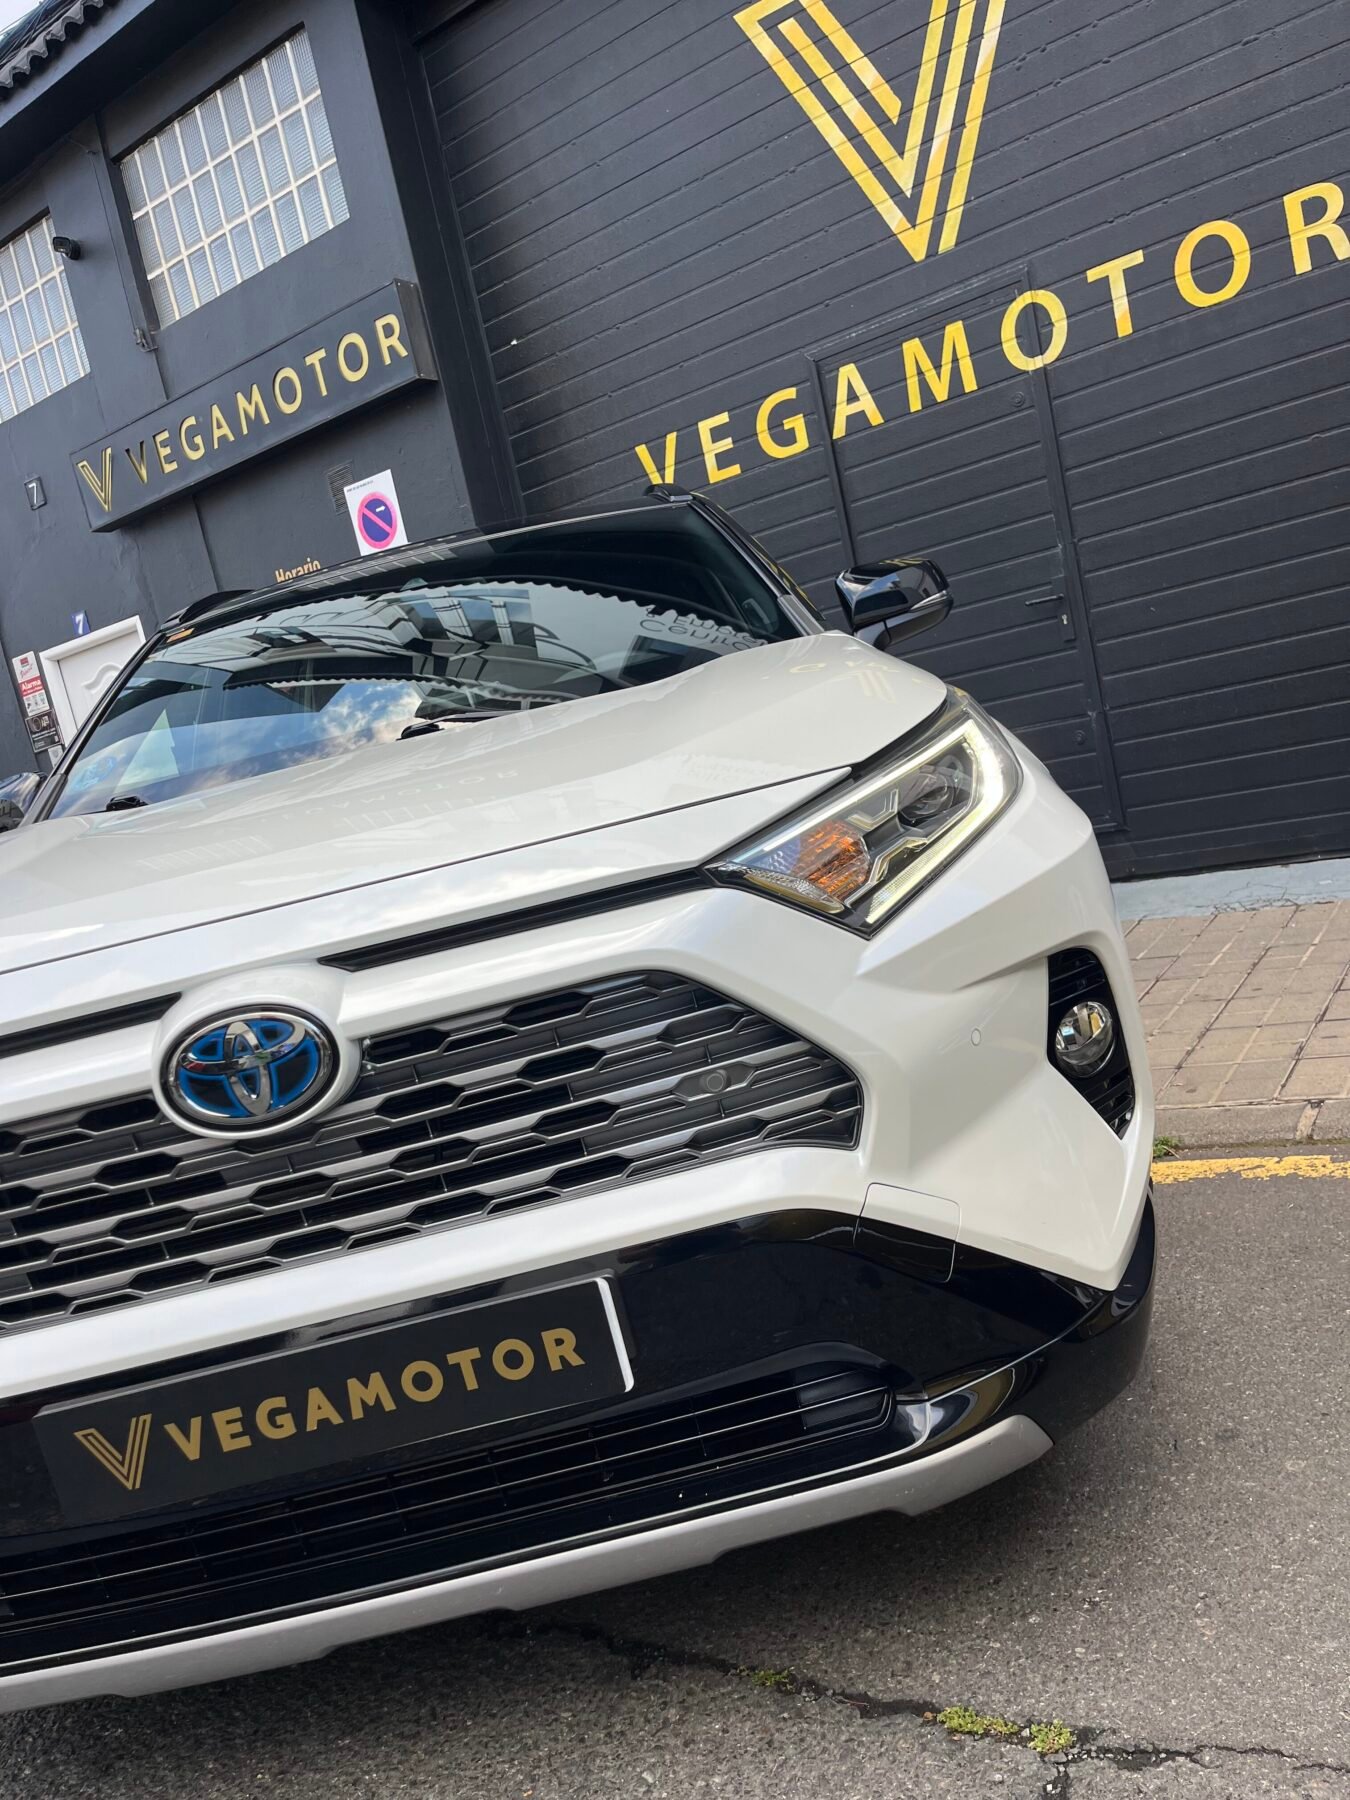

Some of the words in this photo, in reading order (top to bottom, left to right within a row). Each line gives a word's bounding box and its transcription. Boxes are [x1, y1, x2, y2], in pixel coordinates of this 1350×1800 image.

[124, 313, 409, 484] VEGAMOTOR
[634, 182, 1350, 485] VEGAMOTOR
[28, 482, 38, 505] 7
[74, 612, 85, 635] 7
[164, 1327, 586, 1461] VEGAMOTOR
